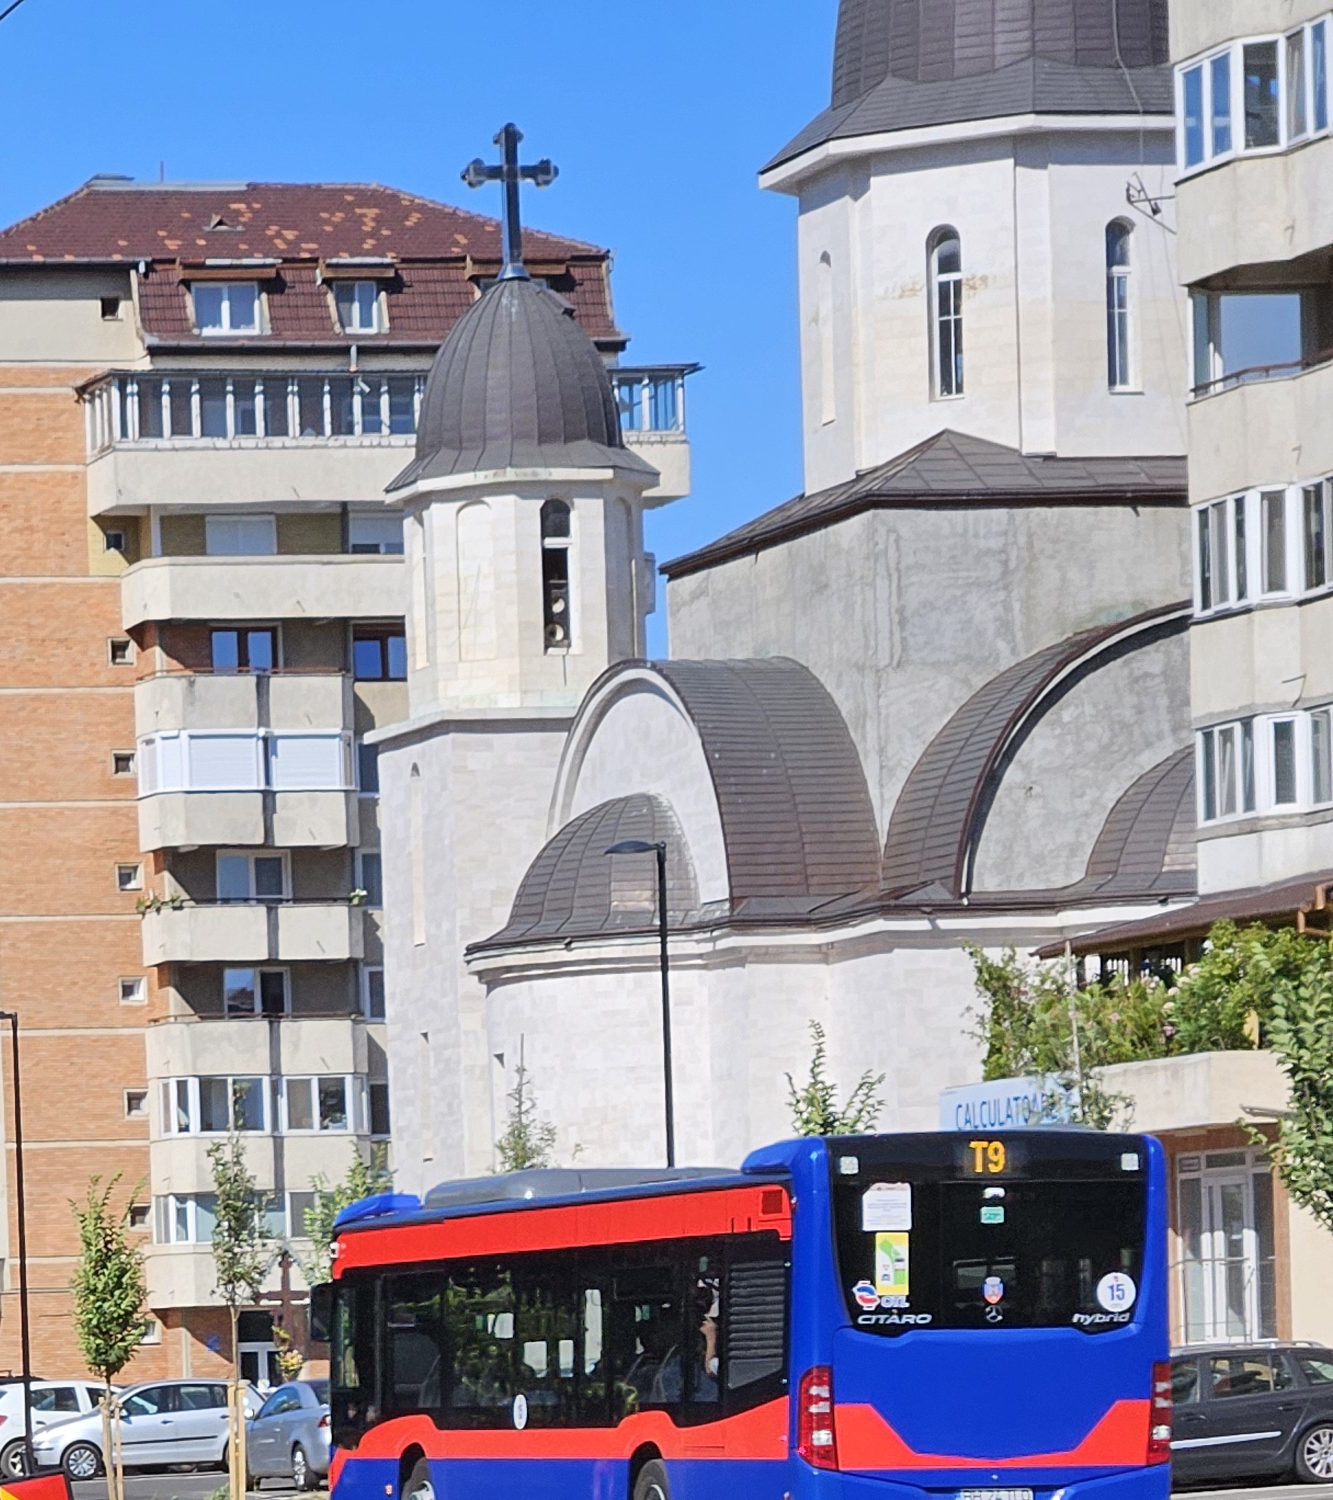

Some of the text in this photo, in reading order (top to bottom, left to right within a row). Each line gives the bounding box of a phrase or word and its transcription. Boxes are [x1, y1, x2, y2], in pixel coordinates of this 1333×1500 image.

[969, 1140, 1006, 1173] T9
[1107, 1283, 1125, 1301] 15
[857, 1313, 933, 1325] CITARO
[1071, 1312, 1130, 1326] hybrid
